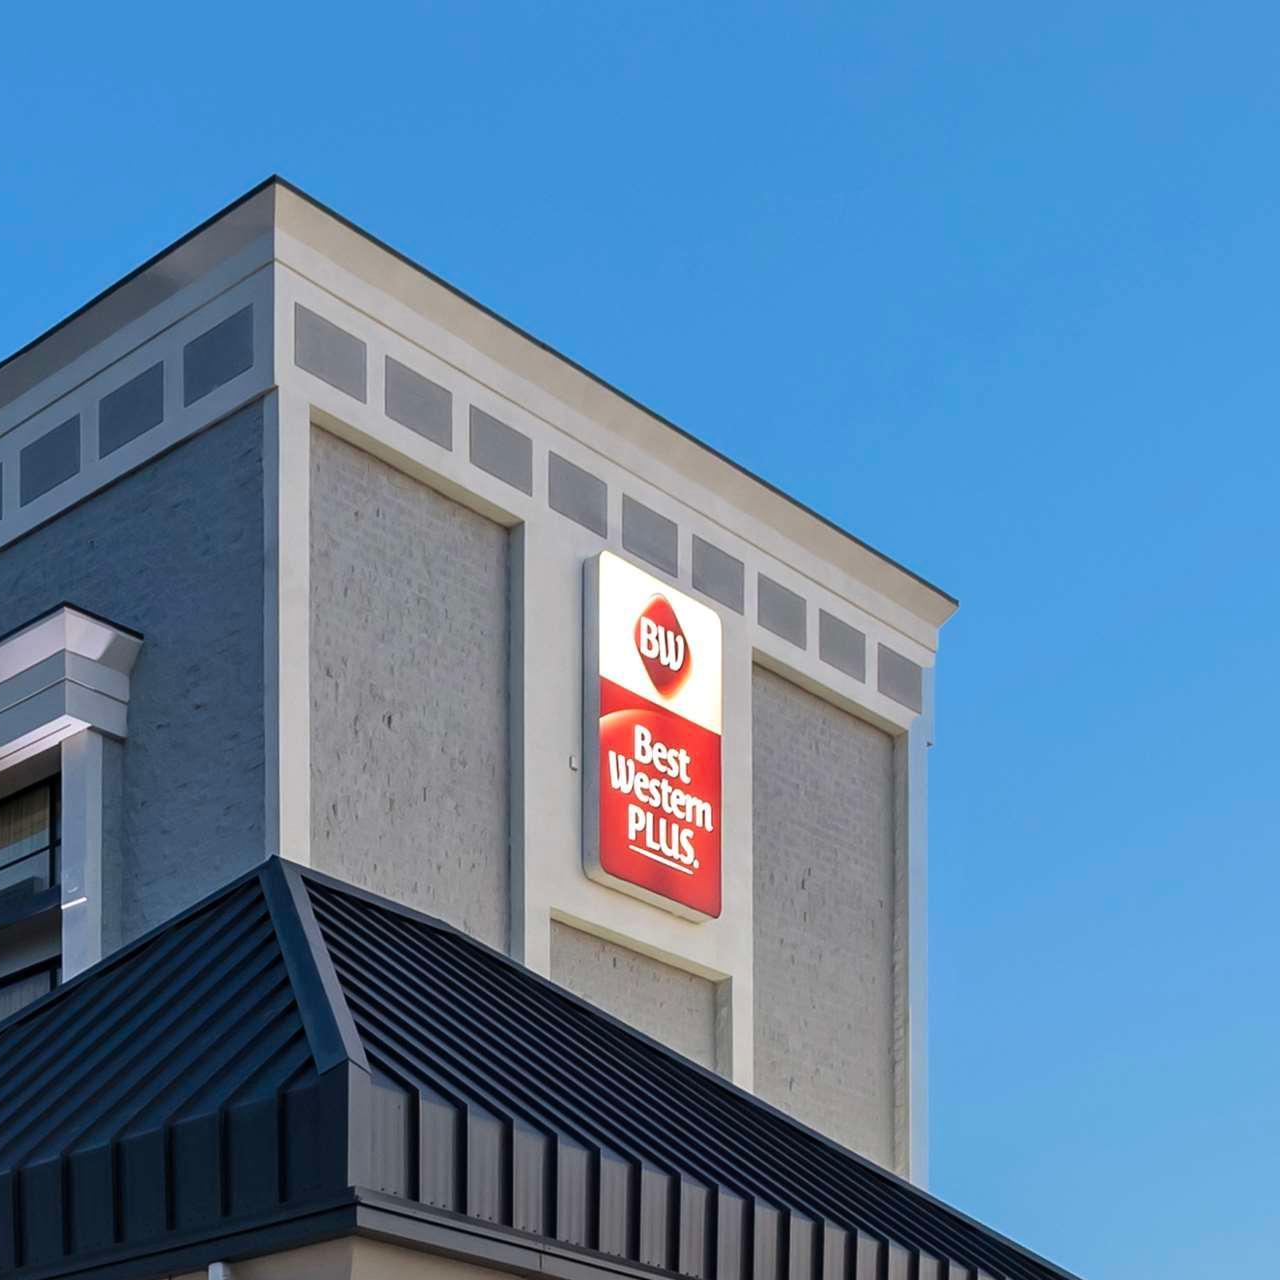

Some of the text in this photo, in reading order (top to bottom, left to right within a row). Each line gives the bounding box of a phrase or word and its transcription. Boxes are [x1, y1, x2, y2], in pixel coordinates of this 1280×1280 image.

[640, 616, 685, 671] BW
[634, 723, 692, 784] Best
[608, 750, 714, 832] Western
